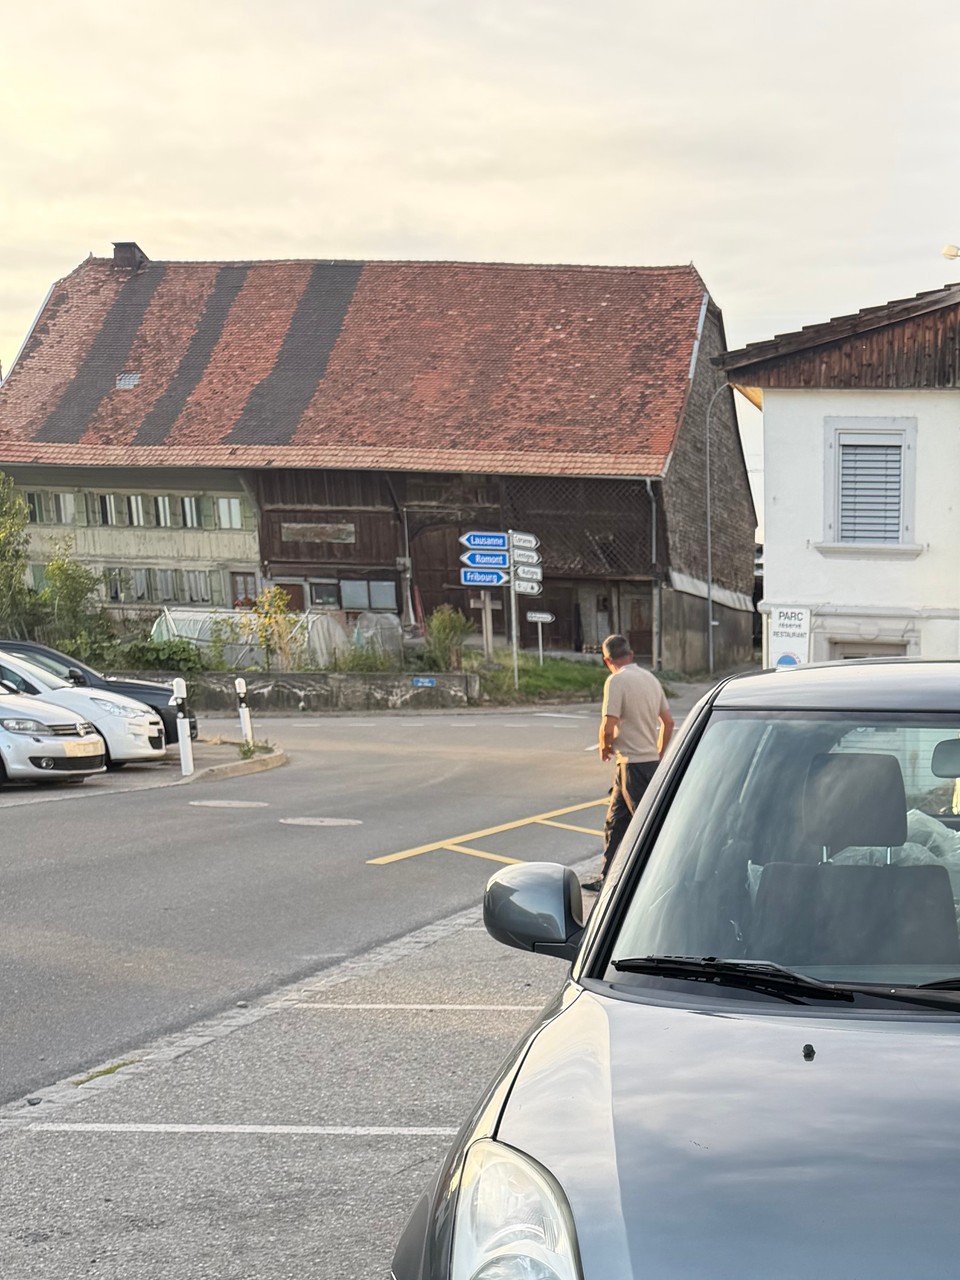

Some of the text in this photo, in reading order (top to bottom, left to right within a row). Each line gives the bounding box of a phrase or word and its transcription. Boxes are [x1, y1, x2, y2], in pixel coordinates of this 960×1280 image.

[471, 536, 503, 546] Lausanne
[475, 554, 503, 564] Romont
[466, 572, 498, 583] Fribourg
[779, 611, 803, 621] PARC
